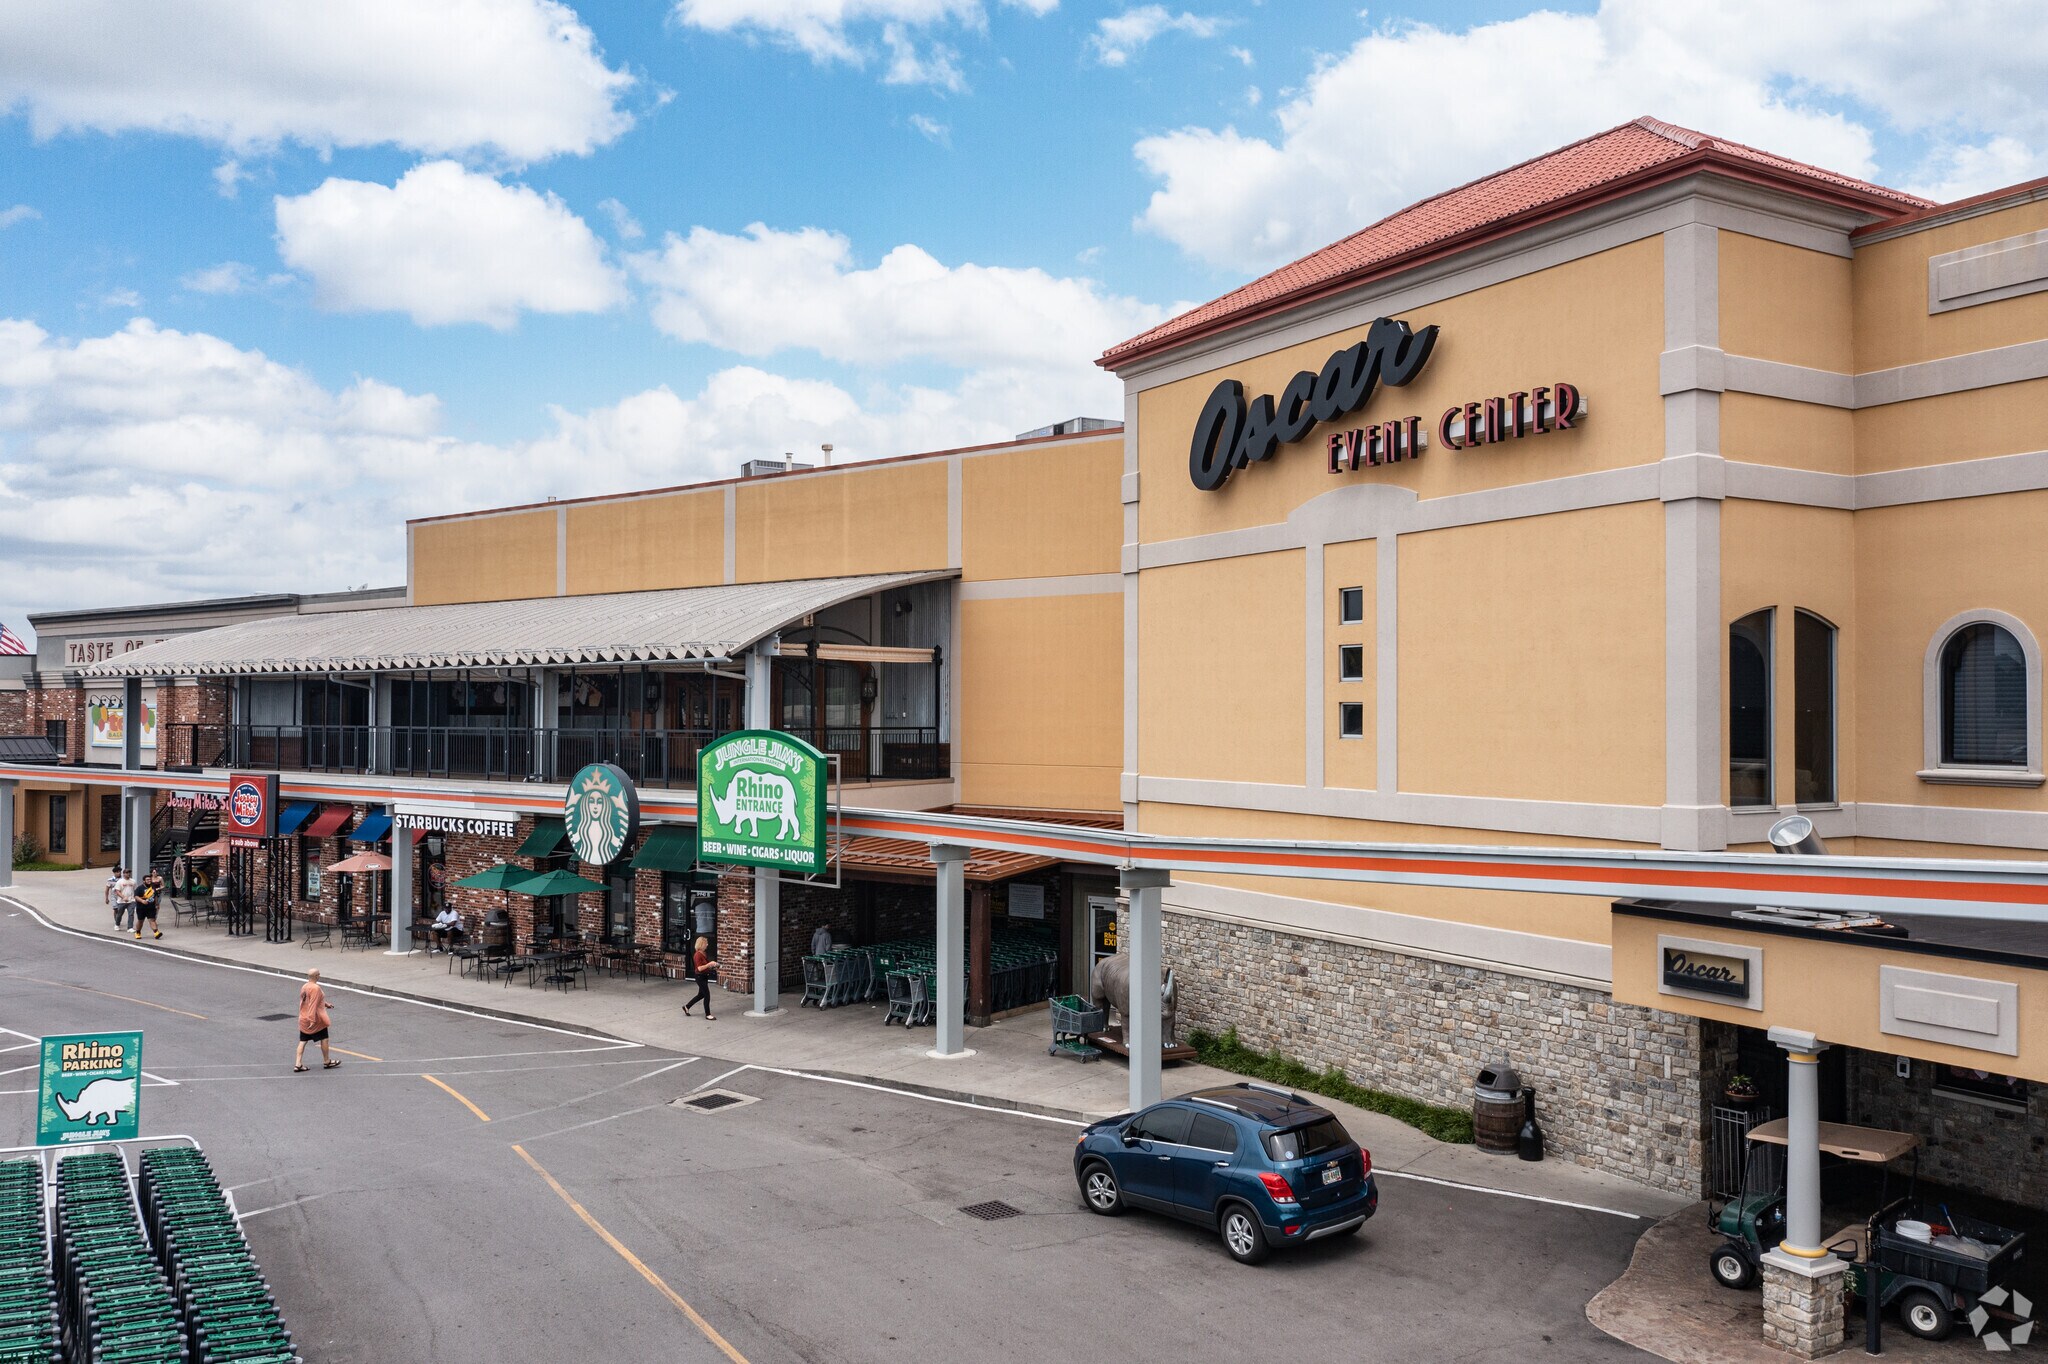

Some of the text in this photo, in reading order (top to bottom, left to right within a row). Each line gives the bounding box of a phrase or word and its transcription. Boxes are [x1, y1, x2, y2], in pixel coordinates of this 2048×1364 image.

[1189, 317, 1440, 491] Oscar
[1328, 383, 1579, 474] EVENT CENTER
[70, 642, 113, 662] TASTE
[715, 739, 804, 774] JUNGLE JIM'S
[733, 756, 782, 767] INTERNATIONAL MARKET
[234, 789, 259, 808] Jersey
[736, 776, 784, 799] Rhino
[167, 790, 192, 812] Jersey
[736, 798, 783, 814] ENTRANCE
[395, 814, 514, 837] STARBUCKS COFFEE
[235, 838, 244, 846] sub
[244, 839, 259, 848] above
[703, 841, 815, 864] BEER WINE CIGARS LIQUOR
[1670, 953, 1736, 983] Oscar
[62, 1040, 124, 1060] Rhino
[62, 1058, 123, 1072] PARKING
